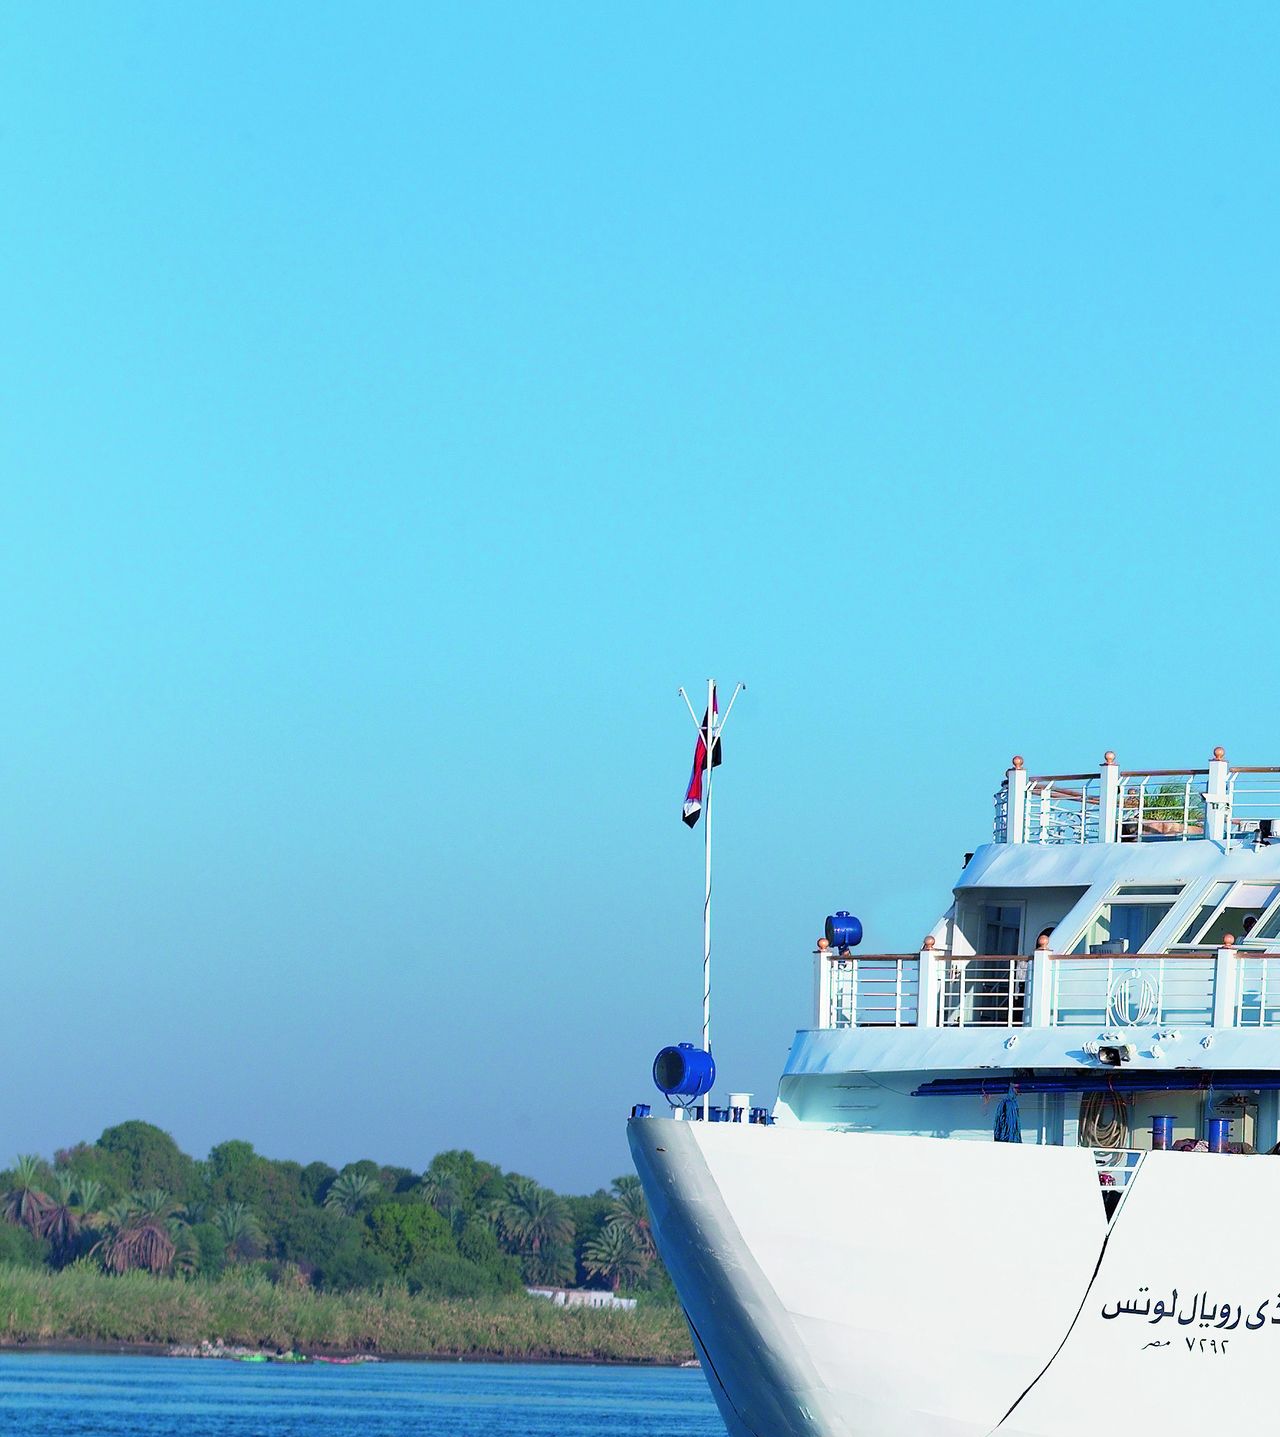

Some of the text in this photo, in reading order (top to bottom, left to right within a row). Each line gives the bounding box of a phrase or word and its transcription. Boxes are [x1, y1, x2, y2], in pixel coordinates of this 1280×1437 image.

[1101, 1287, 1178, 1324] لوتس
[1177, 1290, 1242, 1330] رويال
[1141, 1339, 1171, 1350] مصر
